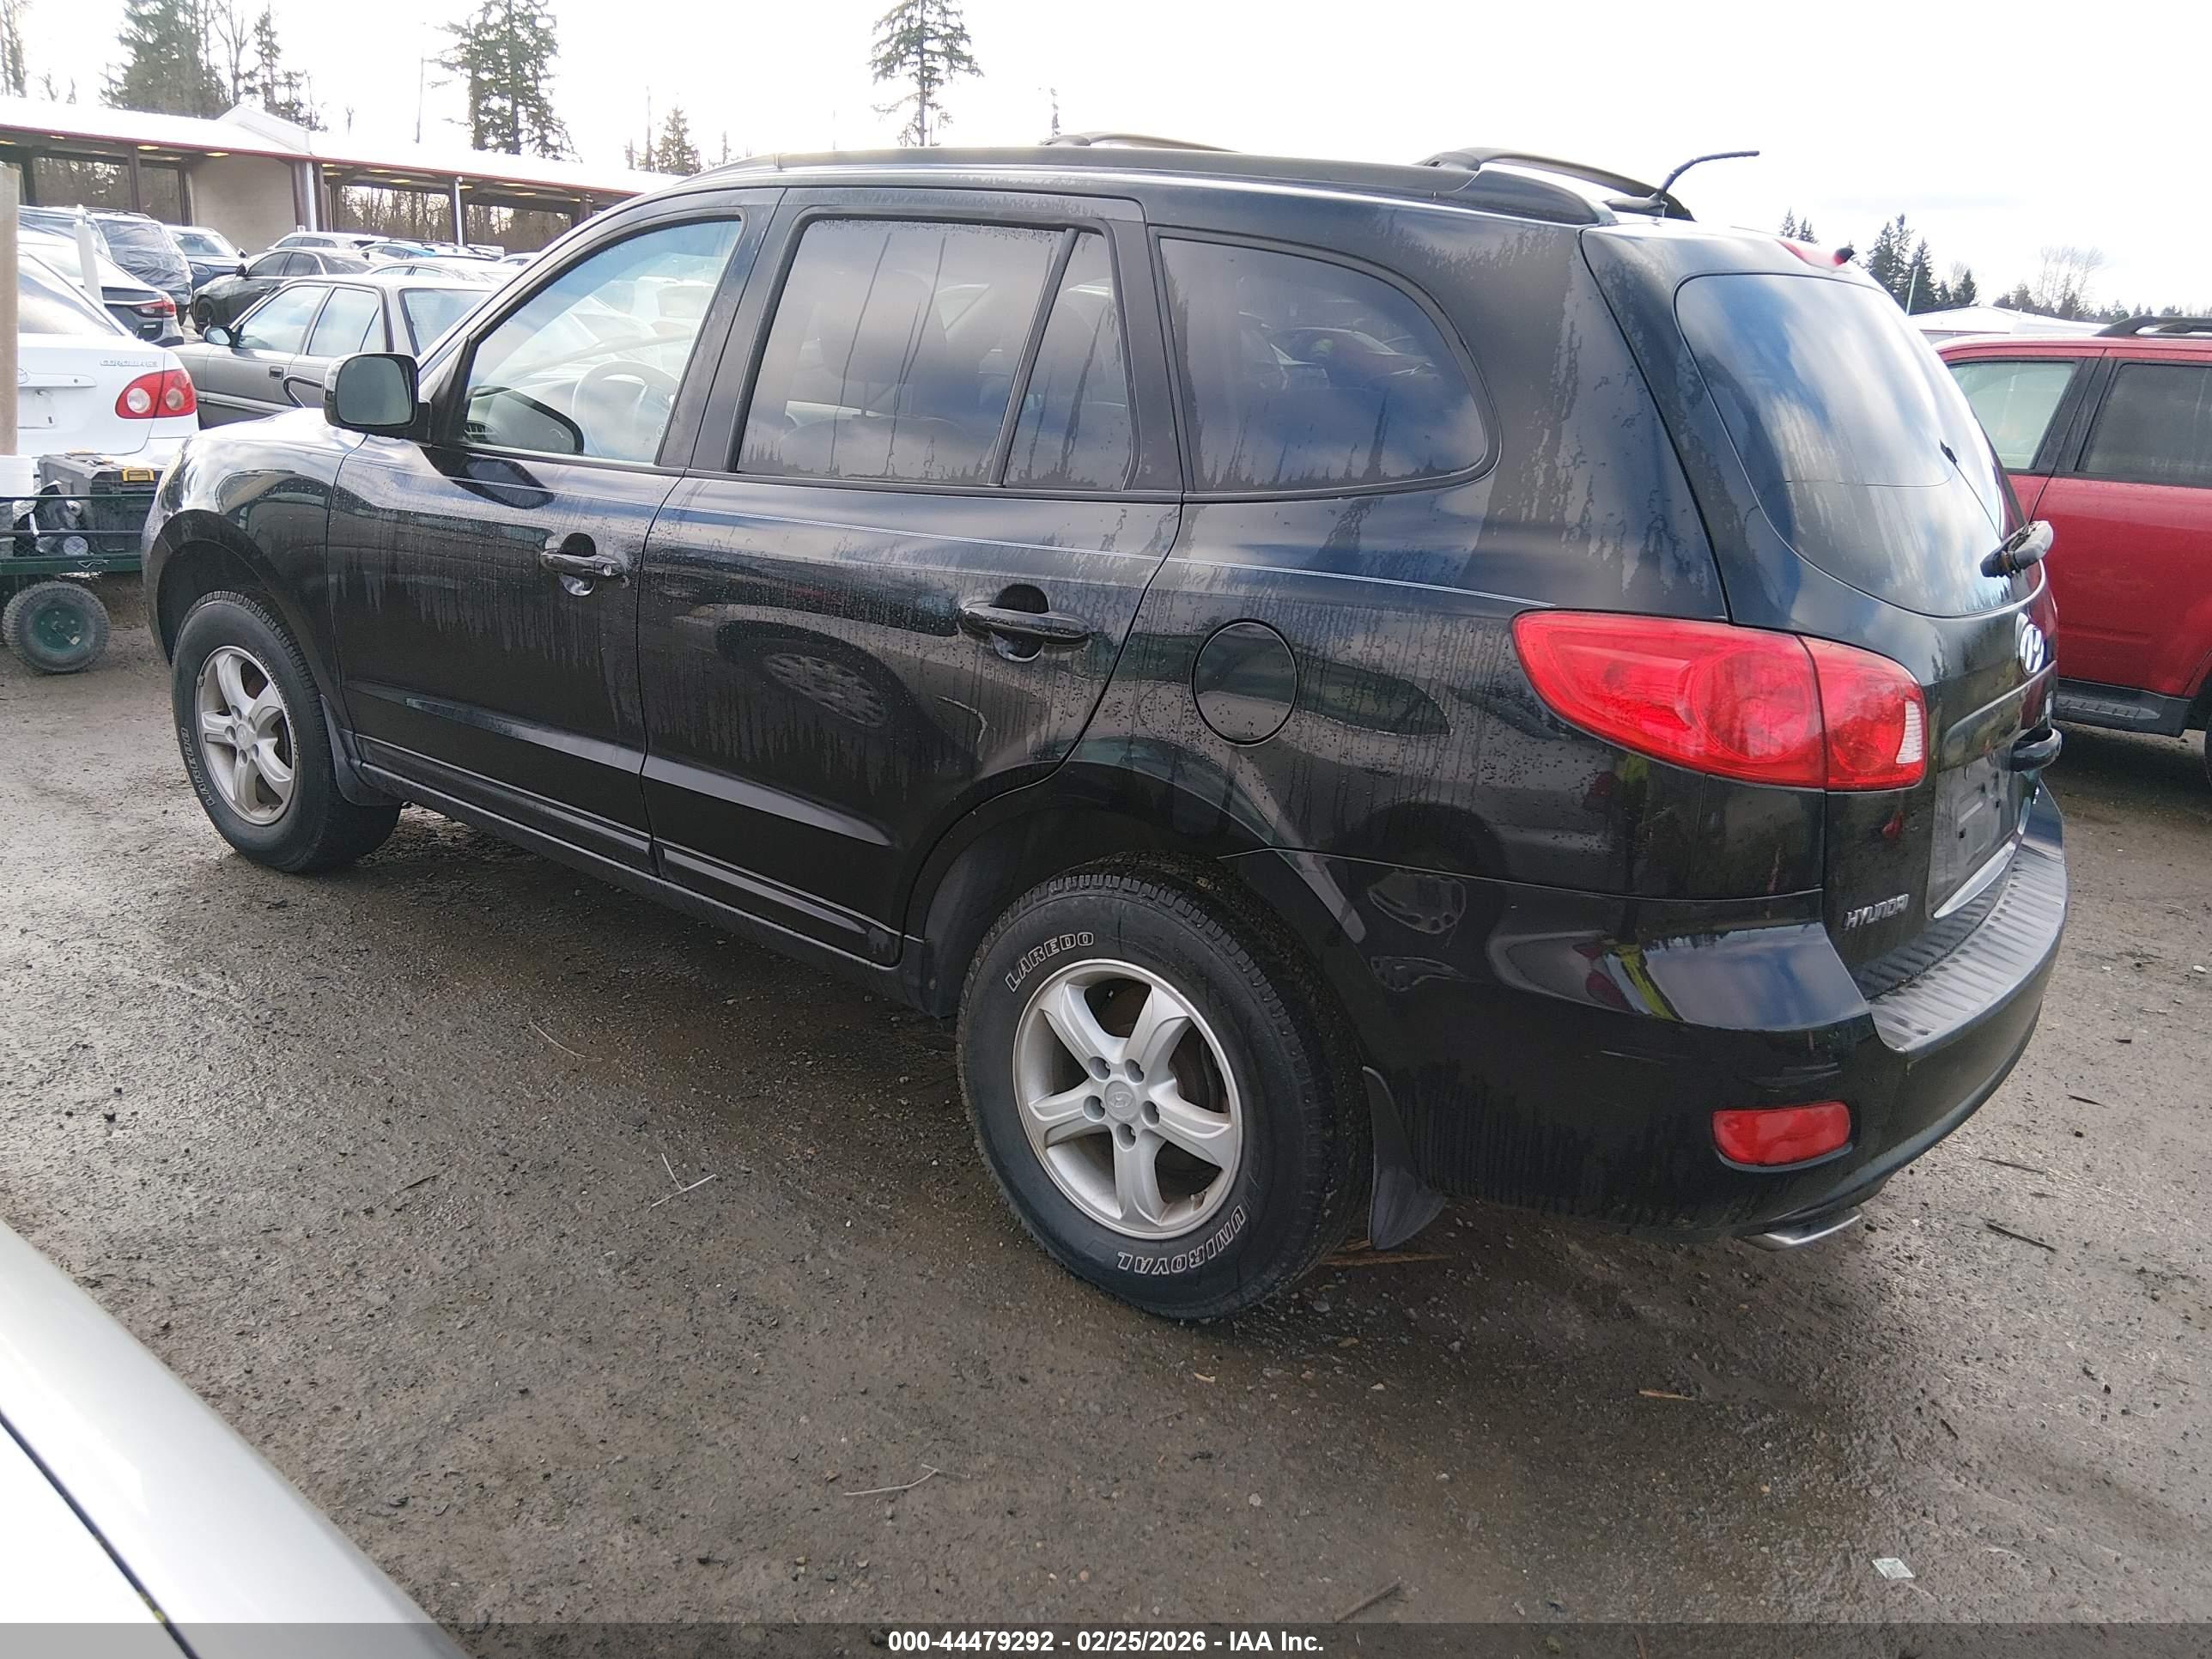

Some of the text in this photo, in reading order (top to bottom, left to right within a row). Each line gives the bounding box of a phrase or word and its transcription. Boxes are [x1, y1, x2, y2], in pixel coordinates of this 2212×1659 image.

[1844, 894, 1909, 930] HYUNDAI
[1005, 932, 1094, 993] LAREDO
[1117, 1205, 1246, 1274] UNIROYAL
